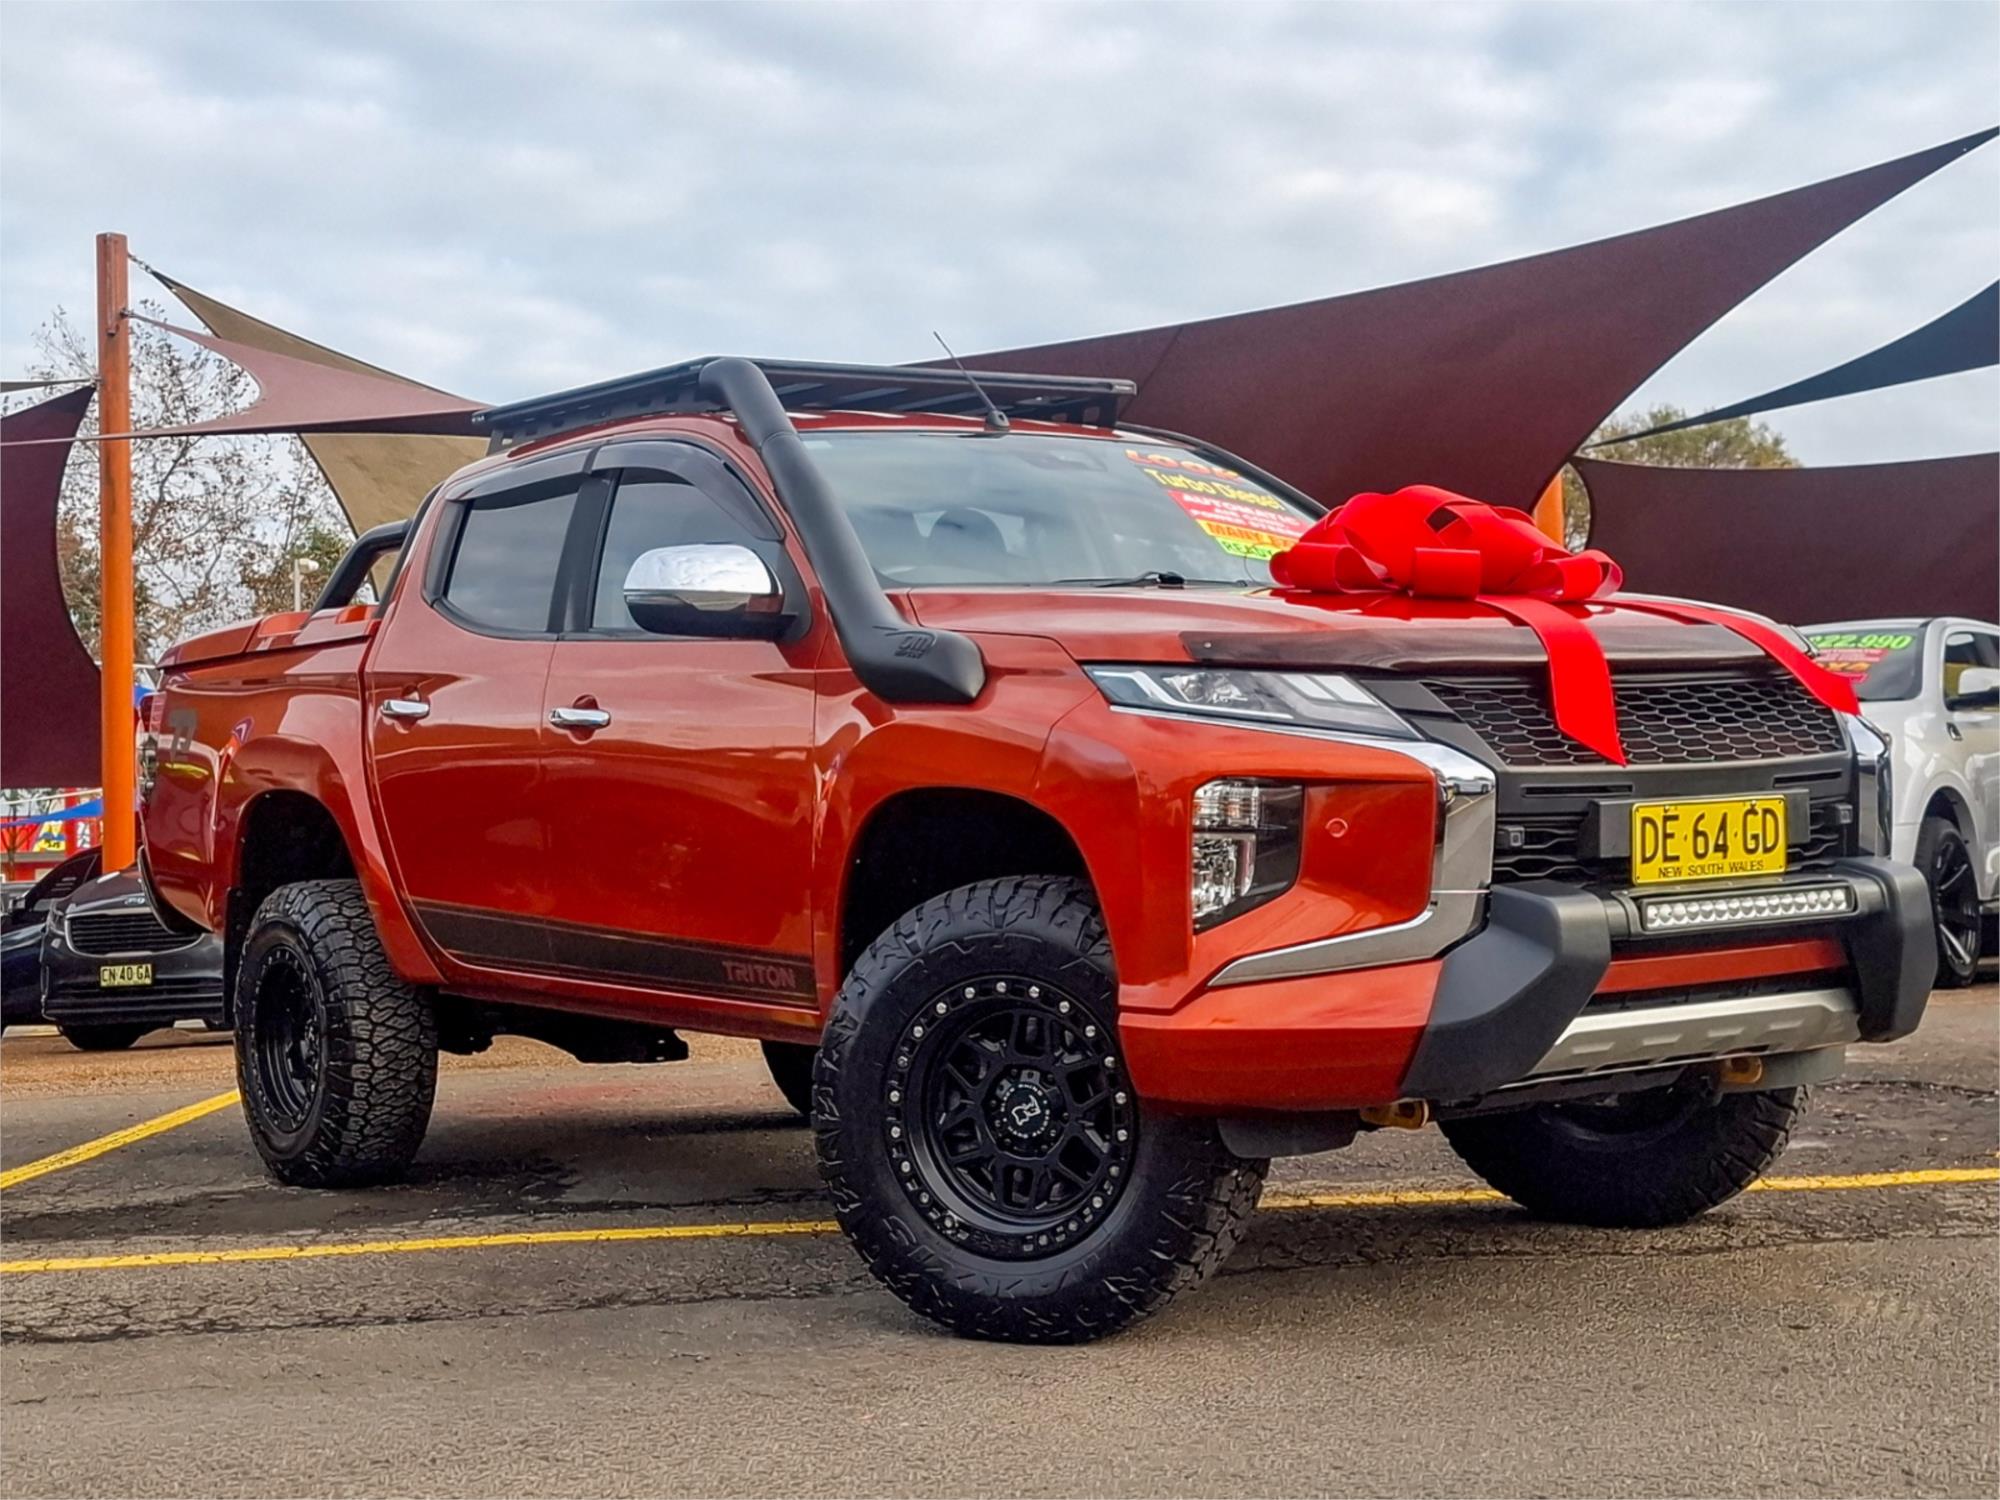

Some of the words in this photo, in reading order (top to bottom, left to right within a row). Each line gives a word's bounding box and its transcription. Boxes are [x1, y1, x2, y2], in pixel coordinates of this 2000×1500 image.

[1144, 467, 1217, 495] Turbo
[1641, 813, 1680, 865] DE
[1692, 811, 1730, 861] 64
[1742, 807, 1780, 856] GD
[1657, 865, 1683, 879] NEW
[1687, 863, 1724, 877] SOUTH
[1728, 860, 1764, 873] WALES
[102, 968, 116, 982] CN
[119, 966, 133, 981] 40
[136, 964, 151, 980] GA
[721, 960, 797, 989] TRITON
